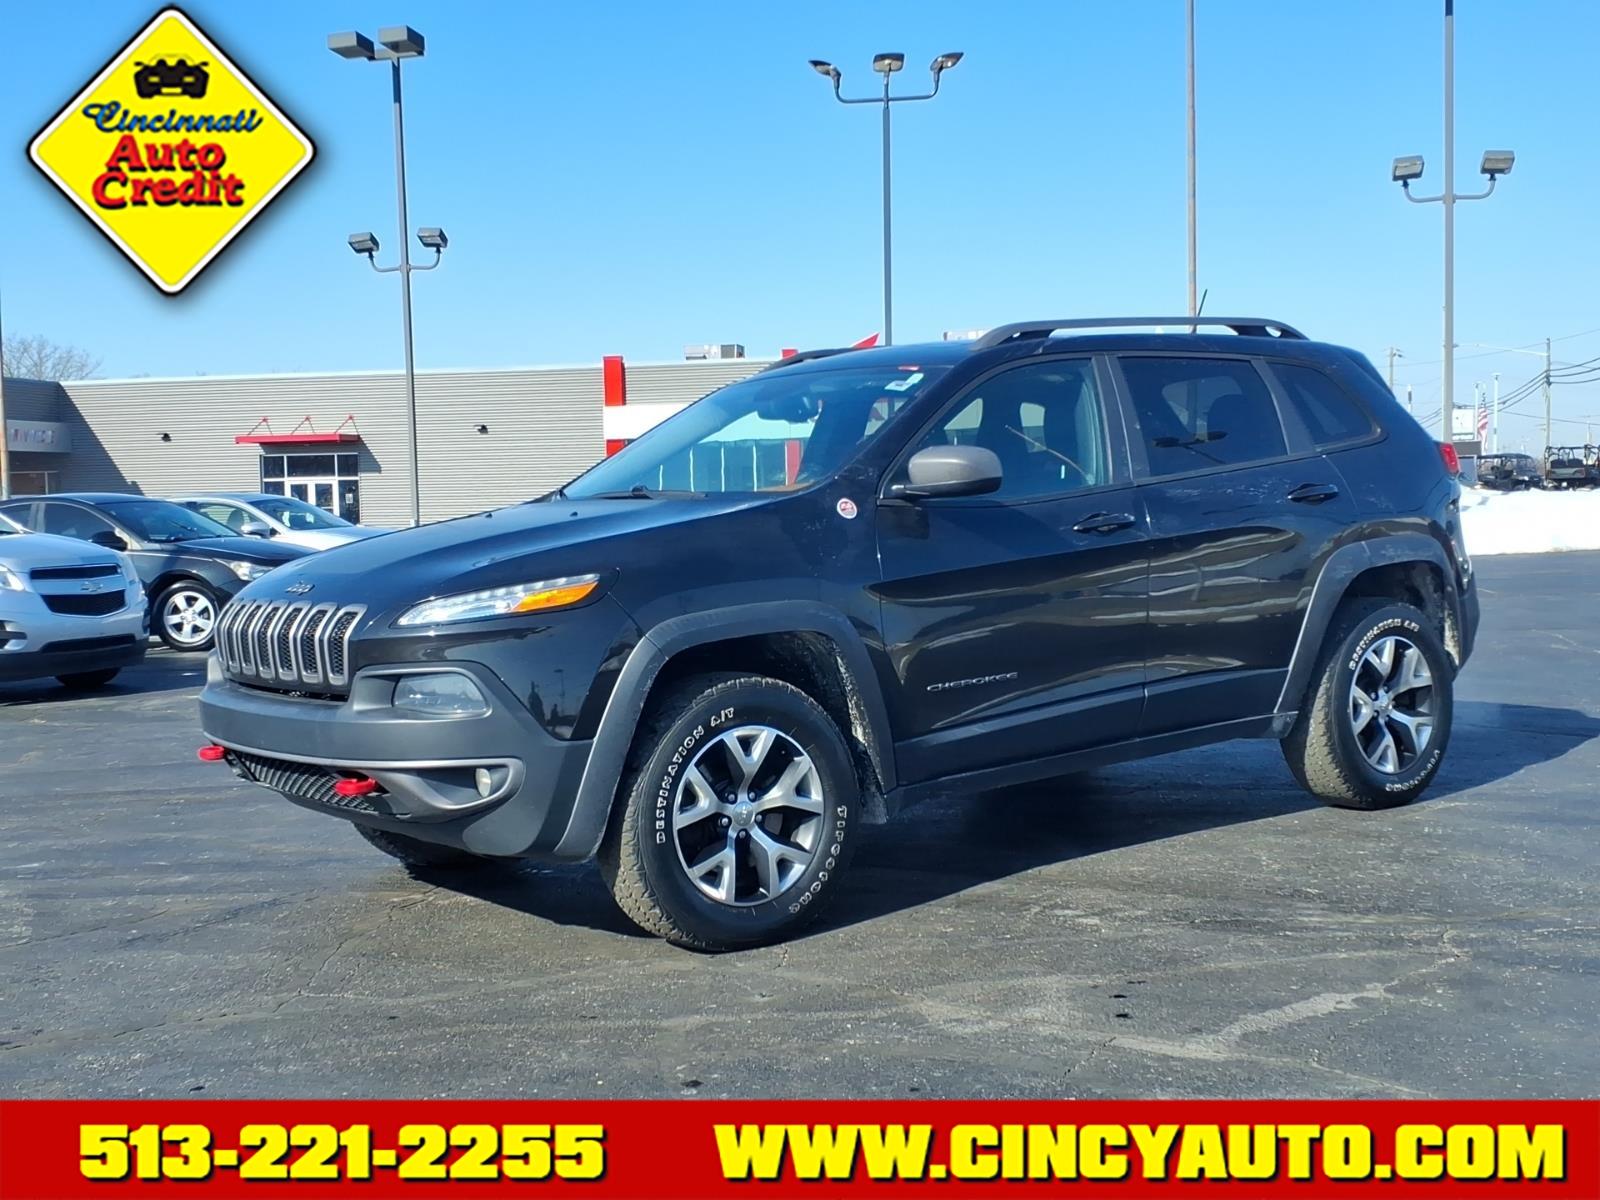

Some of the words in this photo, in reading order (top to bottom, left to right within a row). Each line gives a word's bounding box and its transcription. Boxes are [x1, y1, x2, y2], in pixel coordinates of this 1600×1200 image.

[926, 671, 1018, 692] CHEROKEE
[655, 725, 705, 844] DESTINATION
[710, 707, 735, 727] A/T
